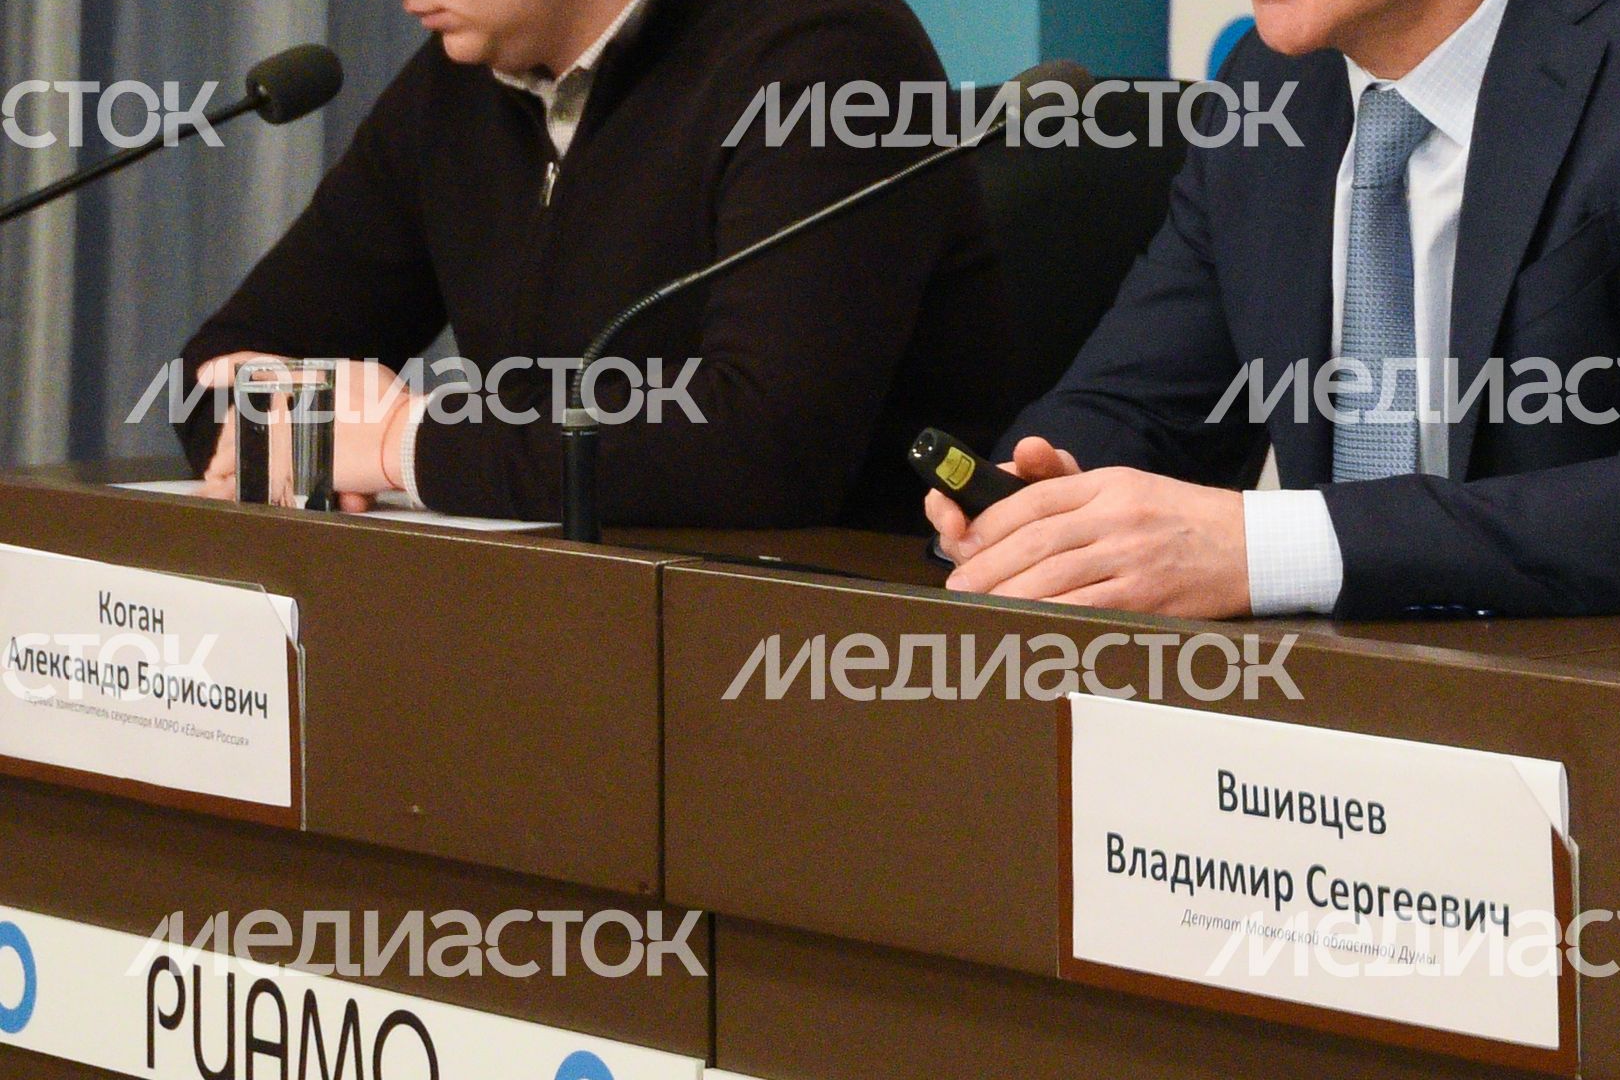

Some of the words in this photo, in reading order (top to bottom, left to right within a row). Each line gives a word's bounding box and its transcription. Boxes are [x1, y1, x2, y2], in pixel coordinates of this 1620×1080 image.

[99, 590, 165, 635] Коган
[7, 636, 130, 699] Александр
[138, 661, 268, 719] Борисович
[1217, 769, 1388, 838] Вшивцев
[1106, 831, 1294, 910] Владимир
[1306, 864, 1511, 937] Сергеевич
[1180, 908, 1242, 932] Депутат
